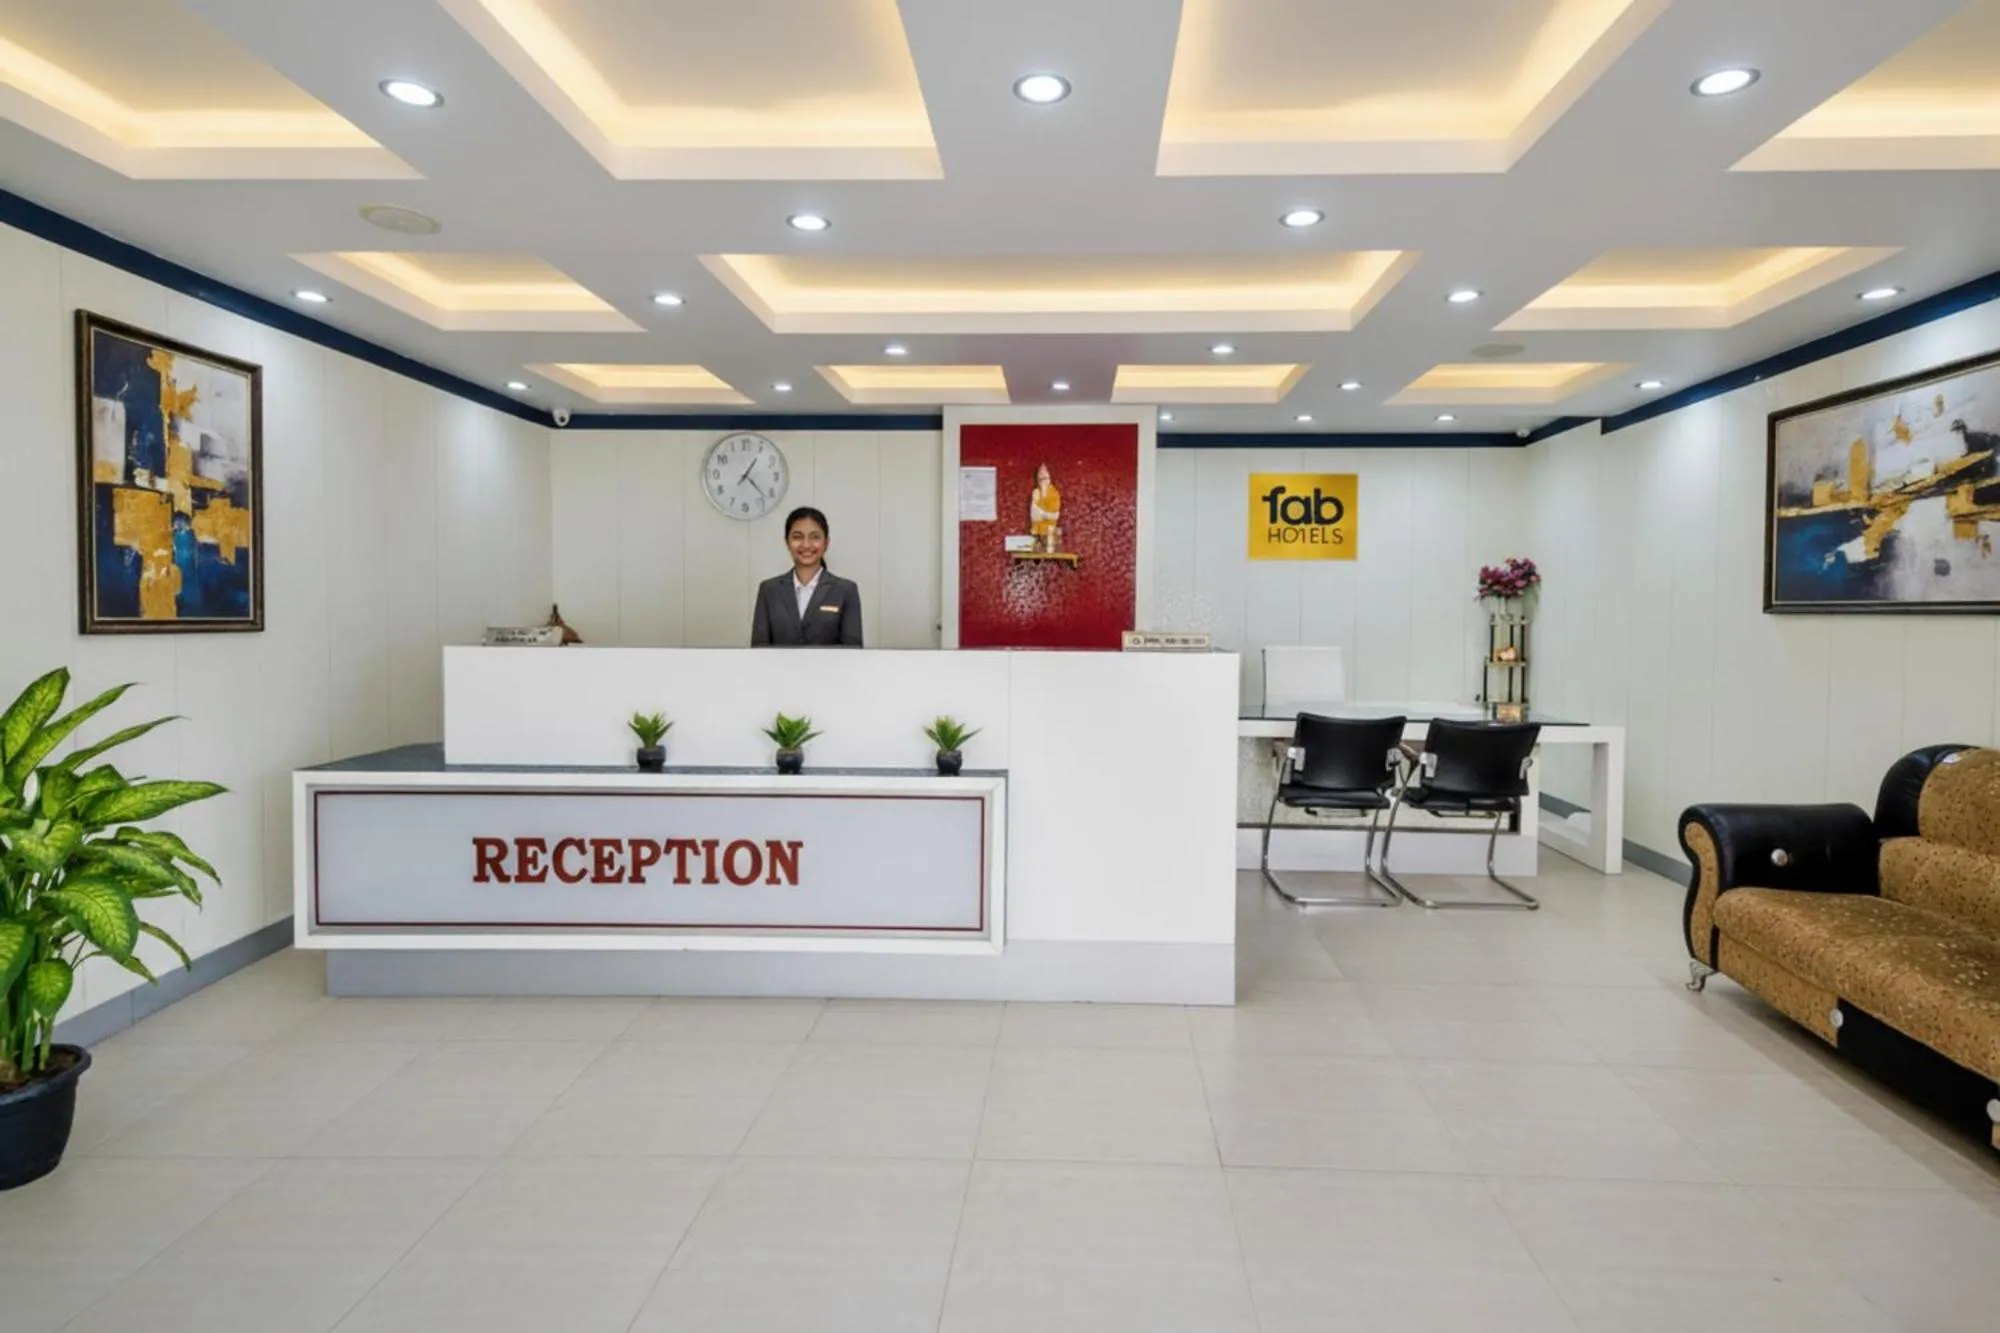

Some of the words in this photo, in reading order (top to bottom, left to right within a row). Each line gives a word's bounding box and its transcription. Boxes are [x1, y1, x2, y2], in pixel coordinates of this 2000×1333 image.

[1261, 485, 1345, 526] fab
[1267, 527, 1344, 545] HOTELS
[472, 837, 804, 887] RECEPTION
